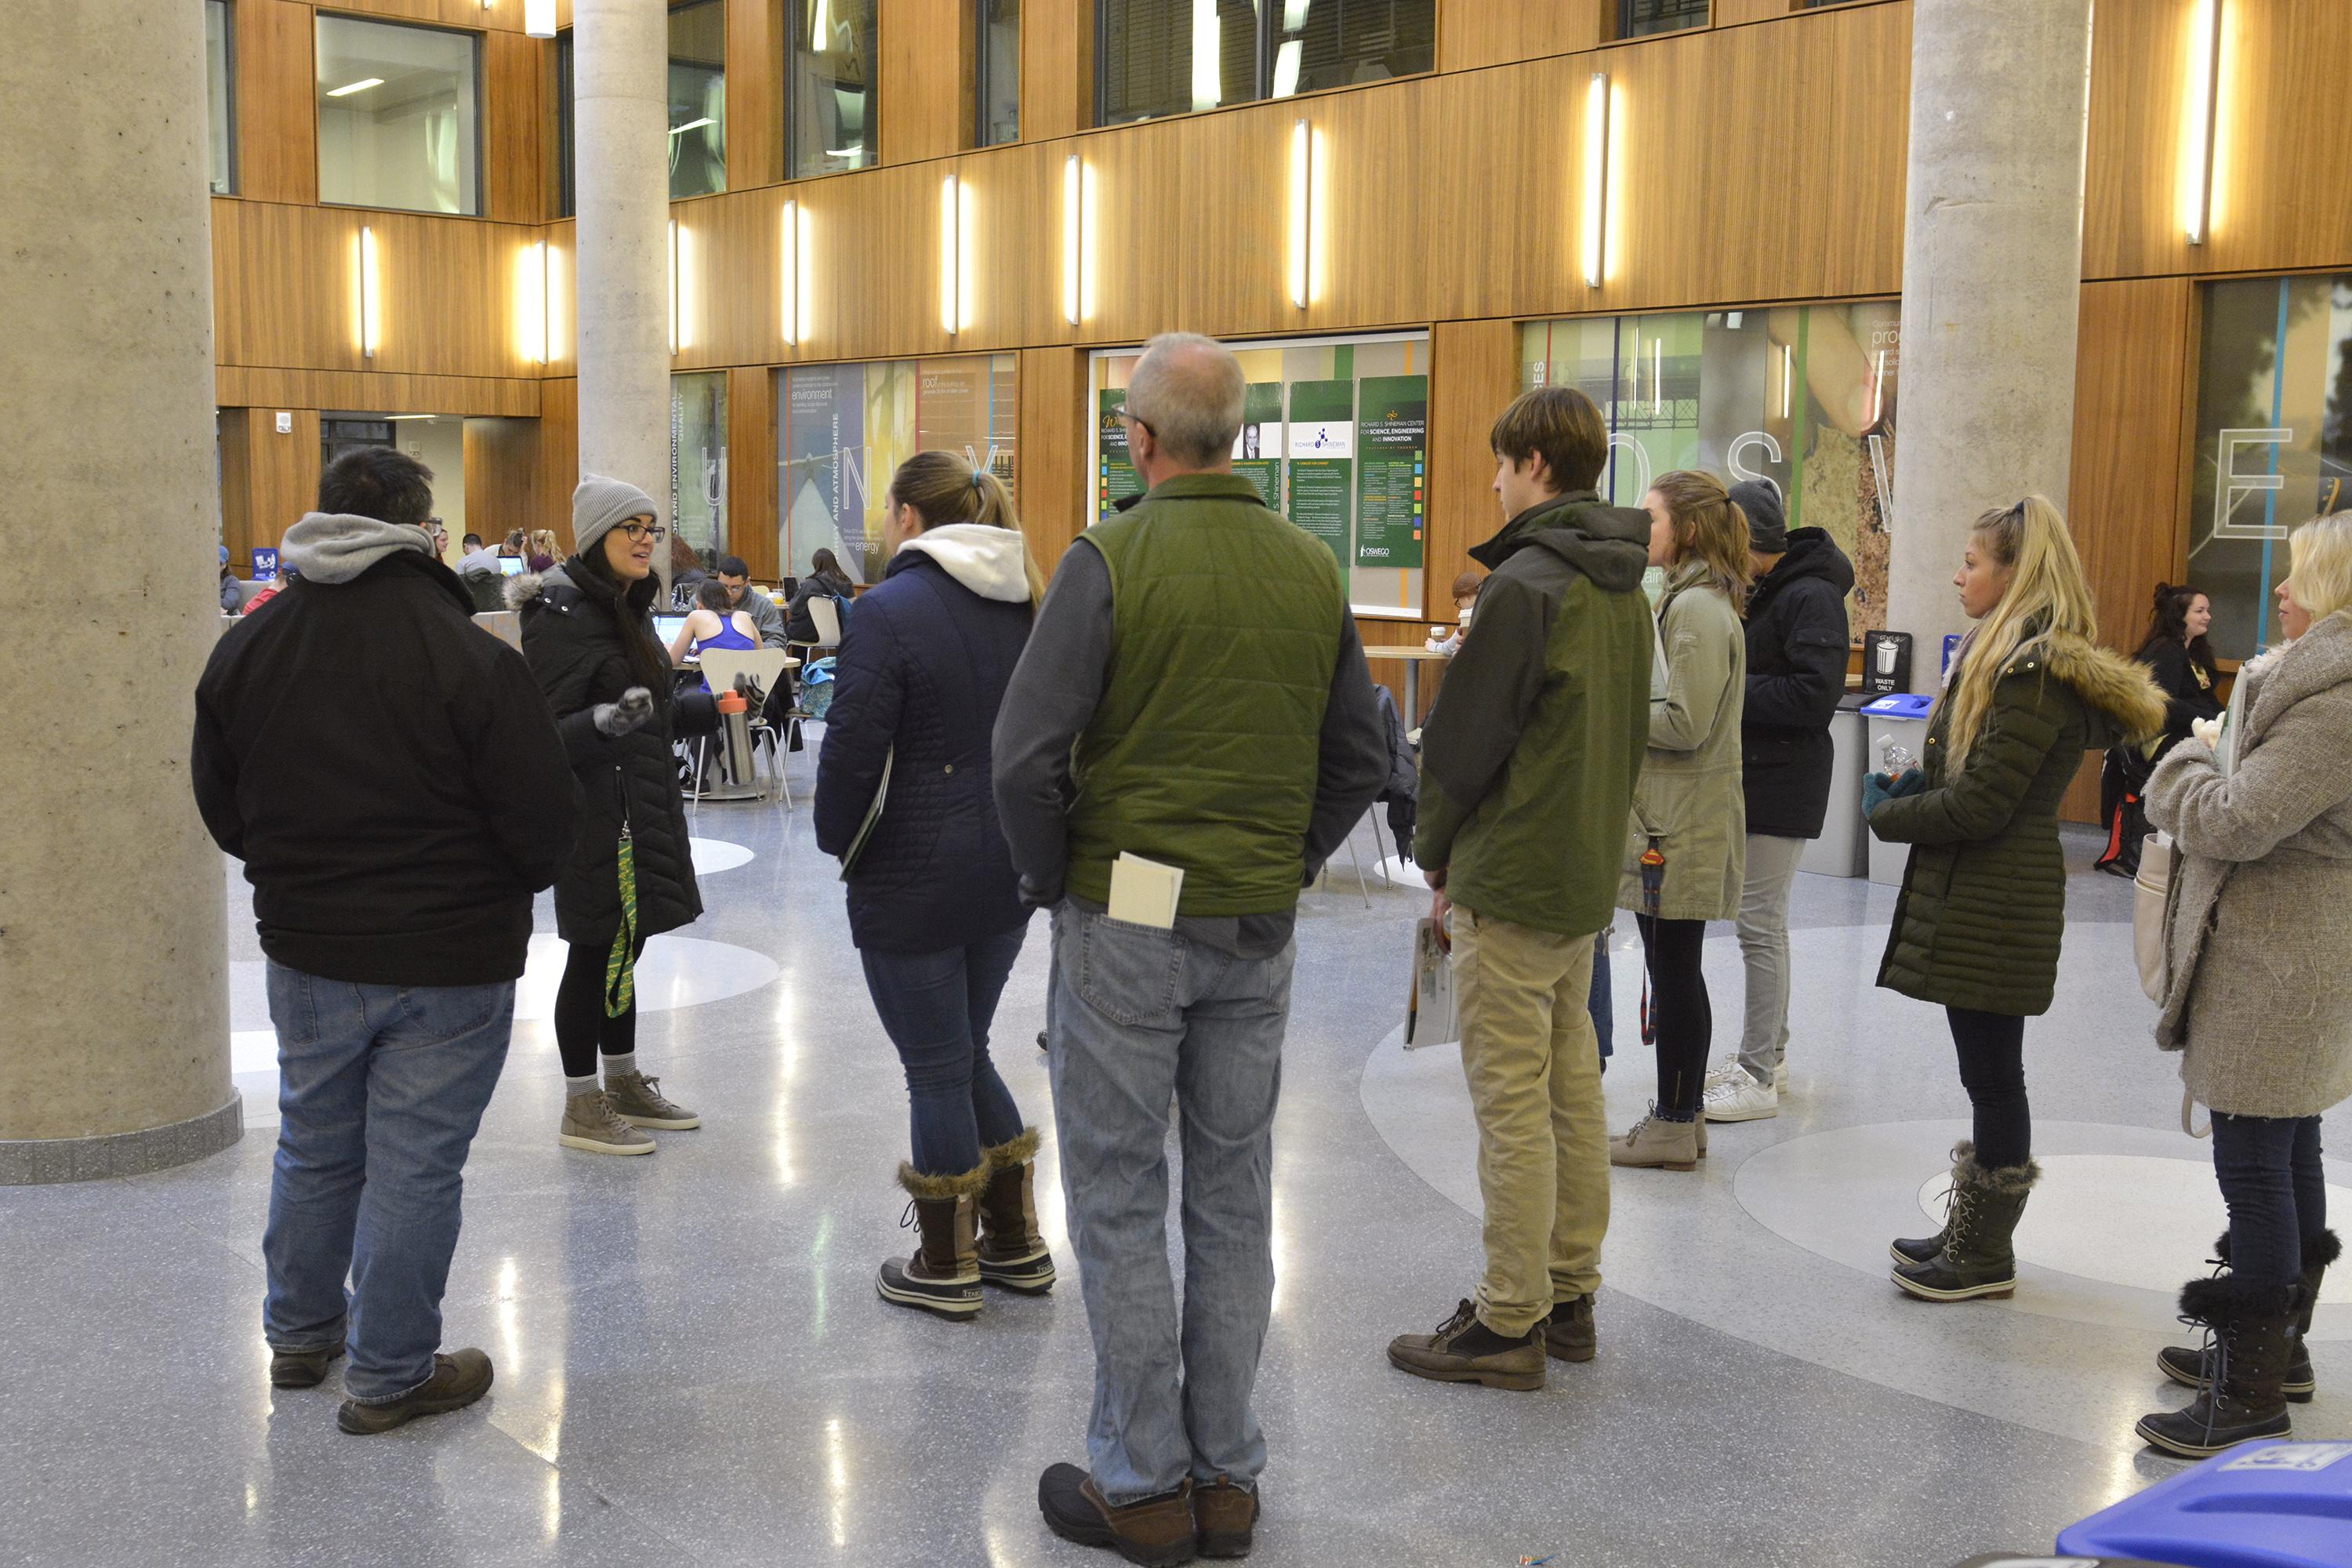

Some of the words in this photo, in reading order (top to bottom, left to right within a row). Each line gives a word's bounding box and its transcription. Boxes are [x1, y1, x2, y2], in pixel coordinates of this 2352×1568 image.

[1872, 330, 1900, 351] pro
[923, 376, 938, 387] roof
[792, 388, 832, 400] environment
[702, 447, 726, 506] U
[844, 446, 871, 510] N
[2213, 428, 2292, 539] E
[855, 542, 880, 554] energy
